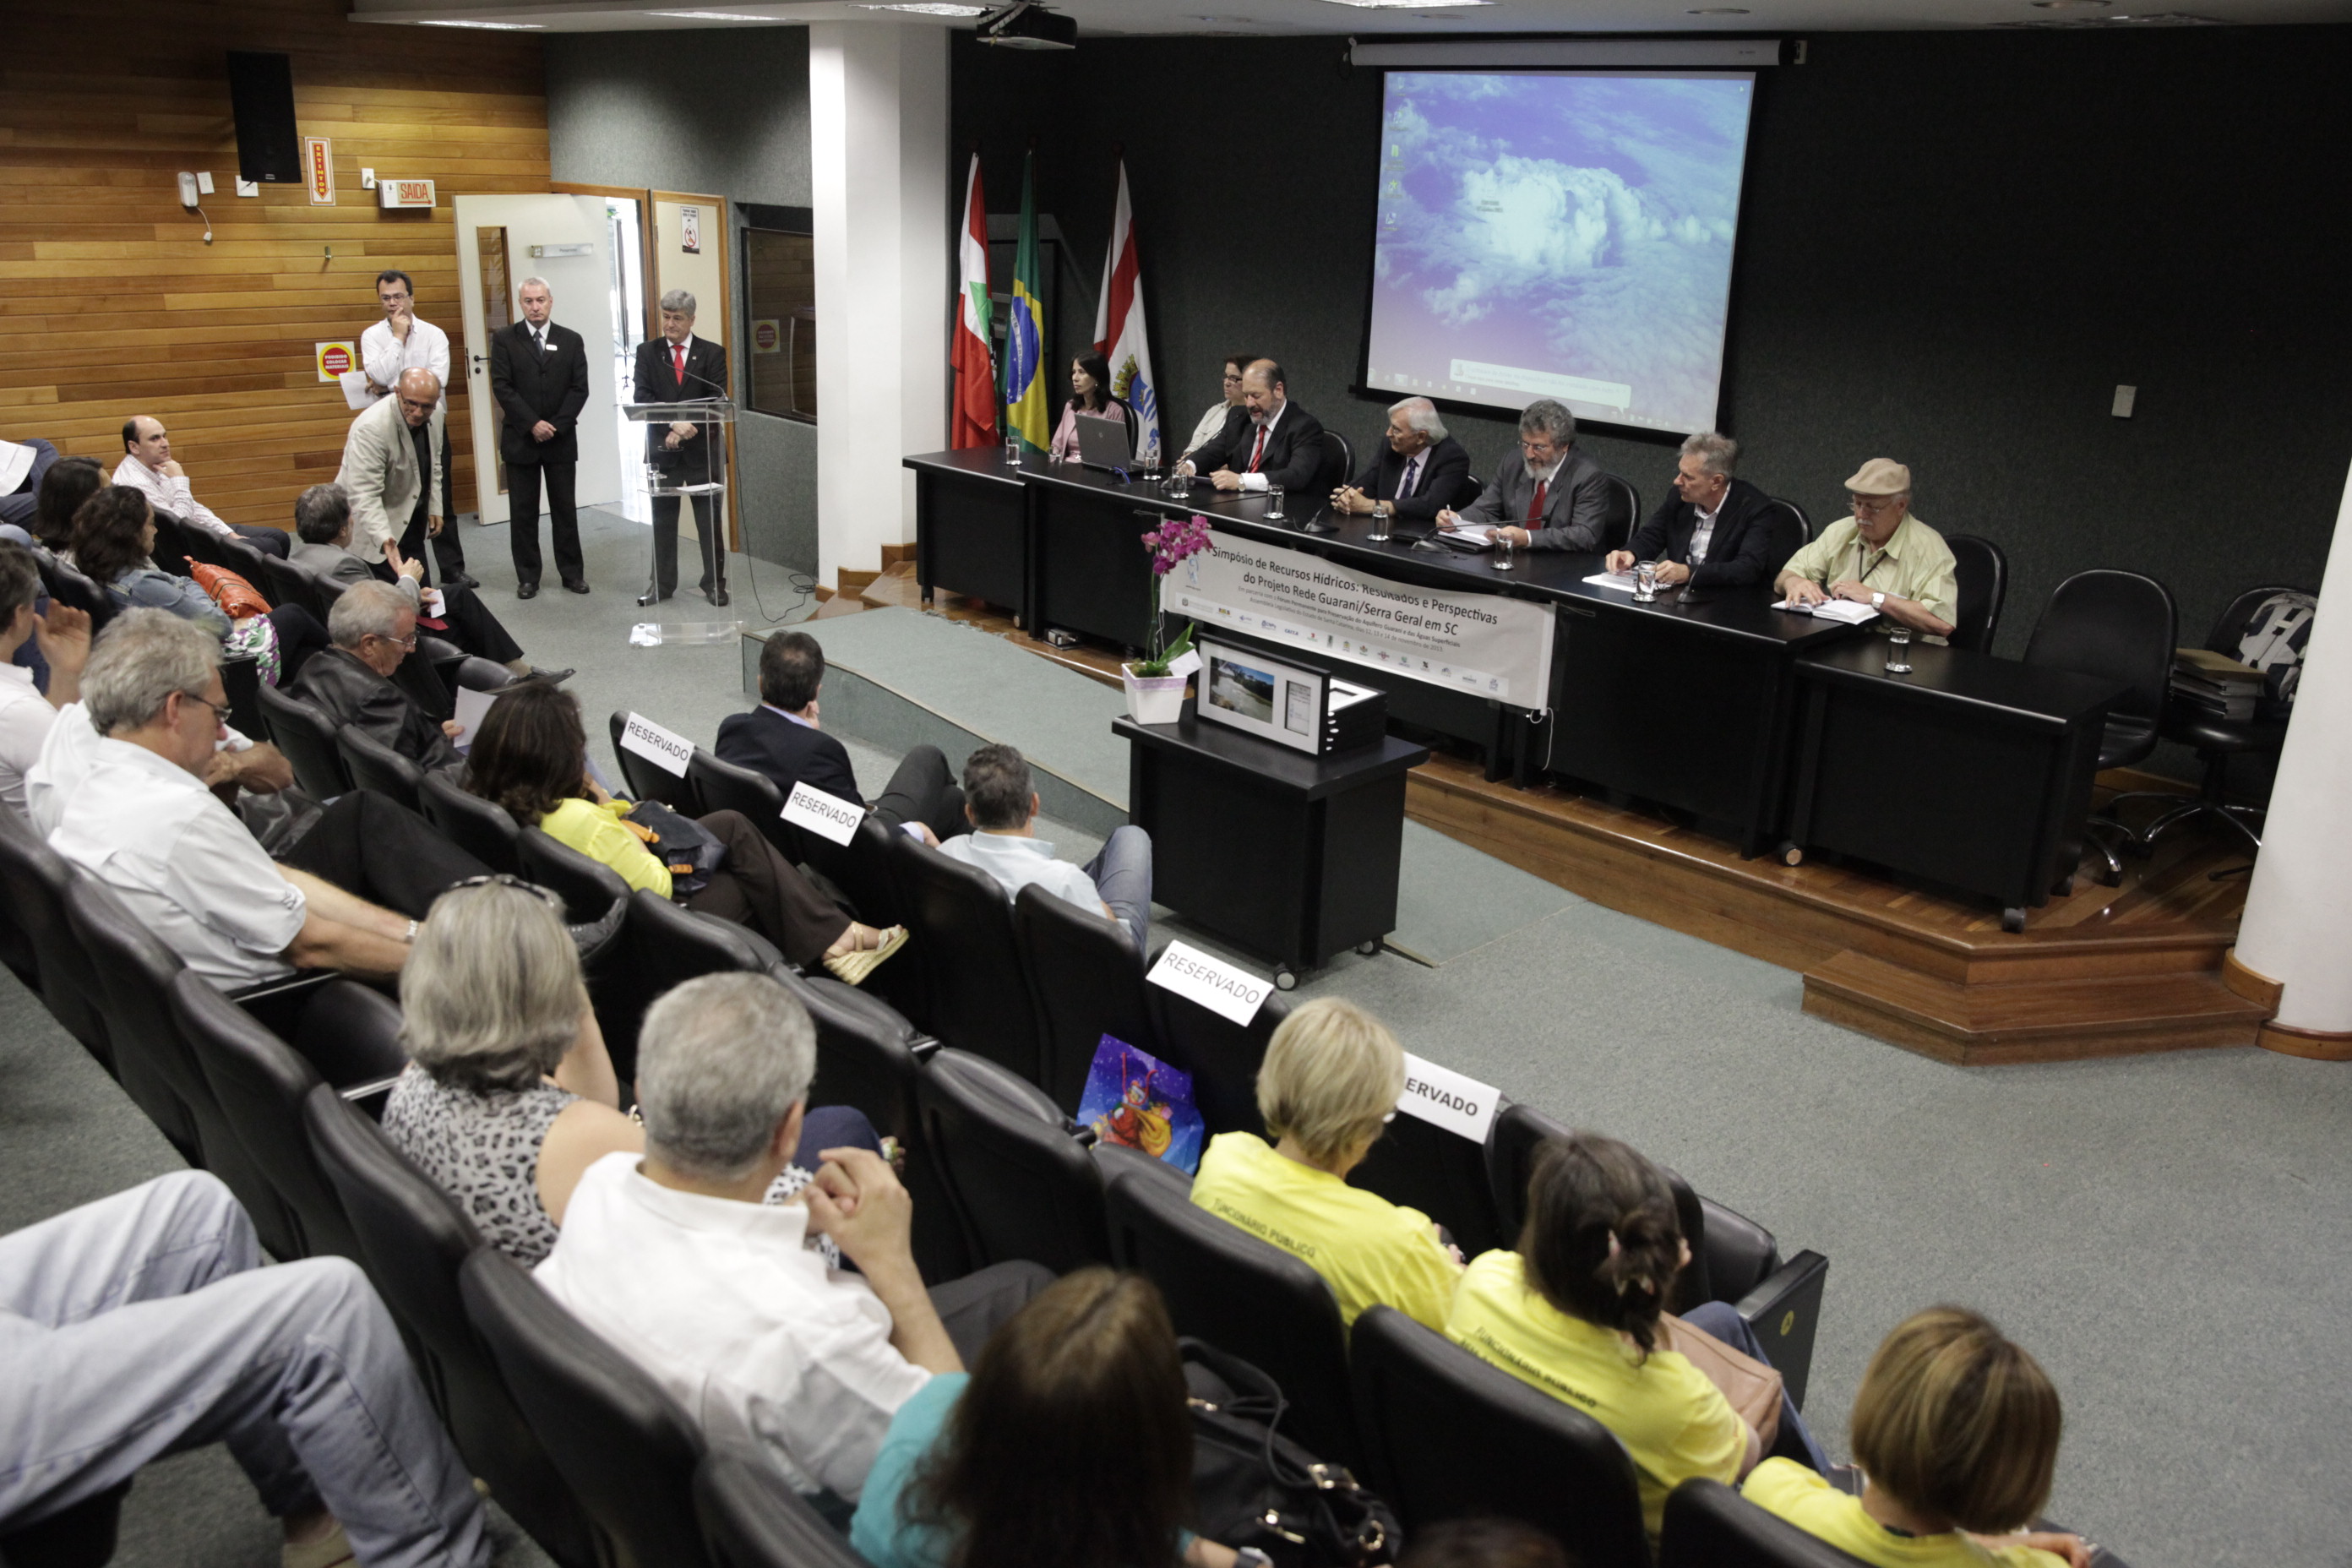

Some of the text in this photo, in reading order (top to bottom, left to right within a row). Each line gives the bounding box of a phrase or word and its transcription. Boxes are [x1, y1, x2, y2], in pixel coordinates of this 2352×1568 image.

[316, 145, 326, 193] EXTINTOR
[1212, 547, 1497, 625] Simpósio de Recursos Hídricos: Resultados e Perspectivas
[1244, 572, 1459, 636] do Projeto Rede Guarani/Serra Geral em SC
[1328, 610, 1354, 622] Preservação
[1384, 624, 1402, 634] Guarani
[1432, 636, 1460, 647] Superficiais
[628, 721, 689, 761] RESERVADO
[792, 792, 857, 828] RESERVADO
[1163, 952, 1260, 1004] RESERVADO
[1405, 1078, 1478, 1116] ERVADO
